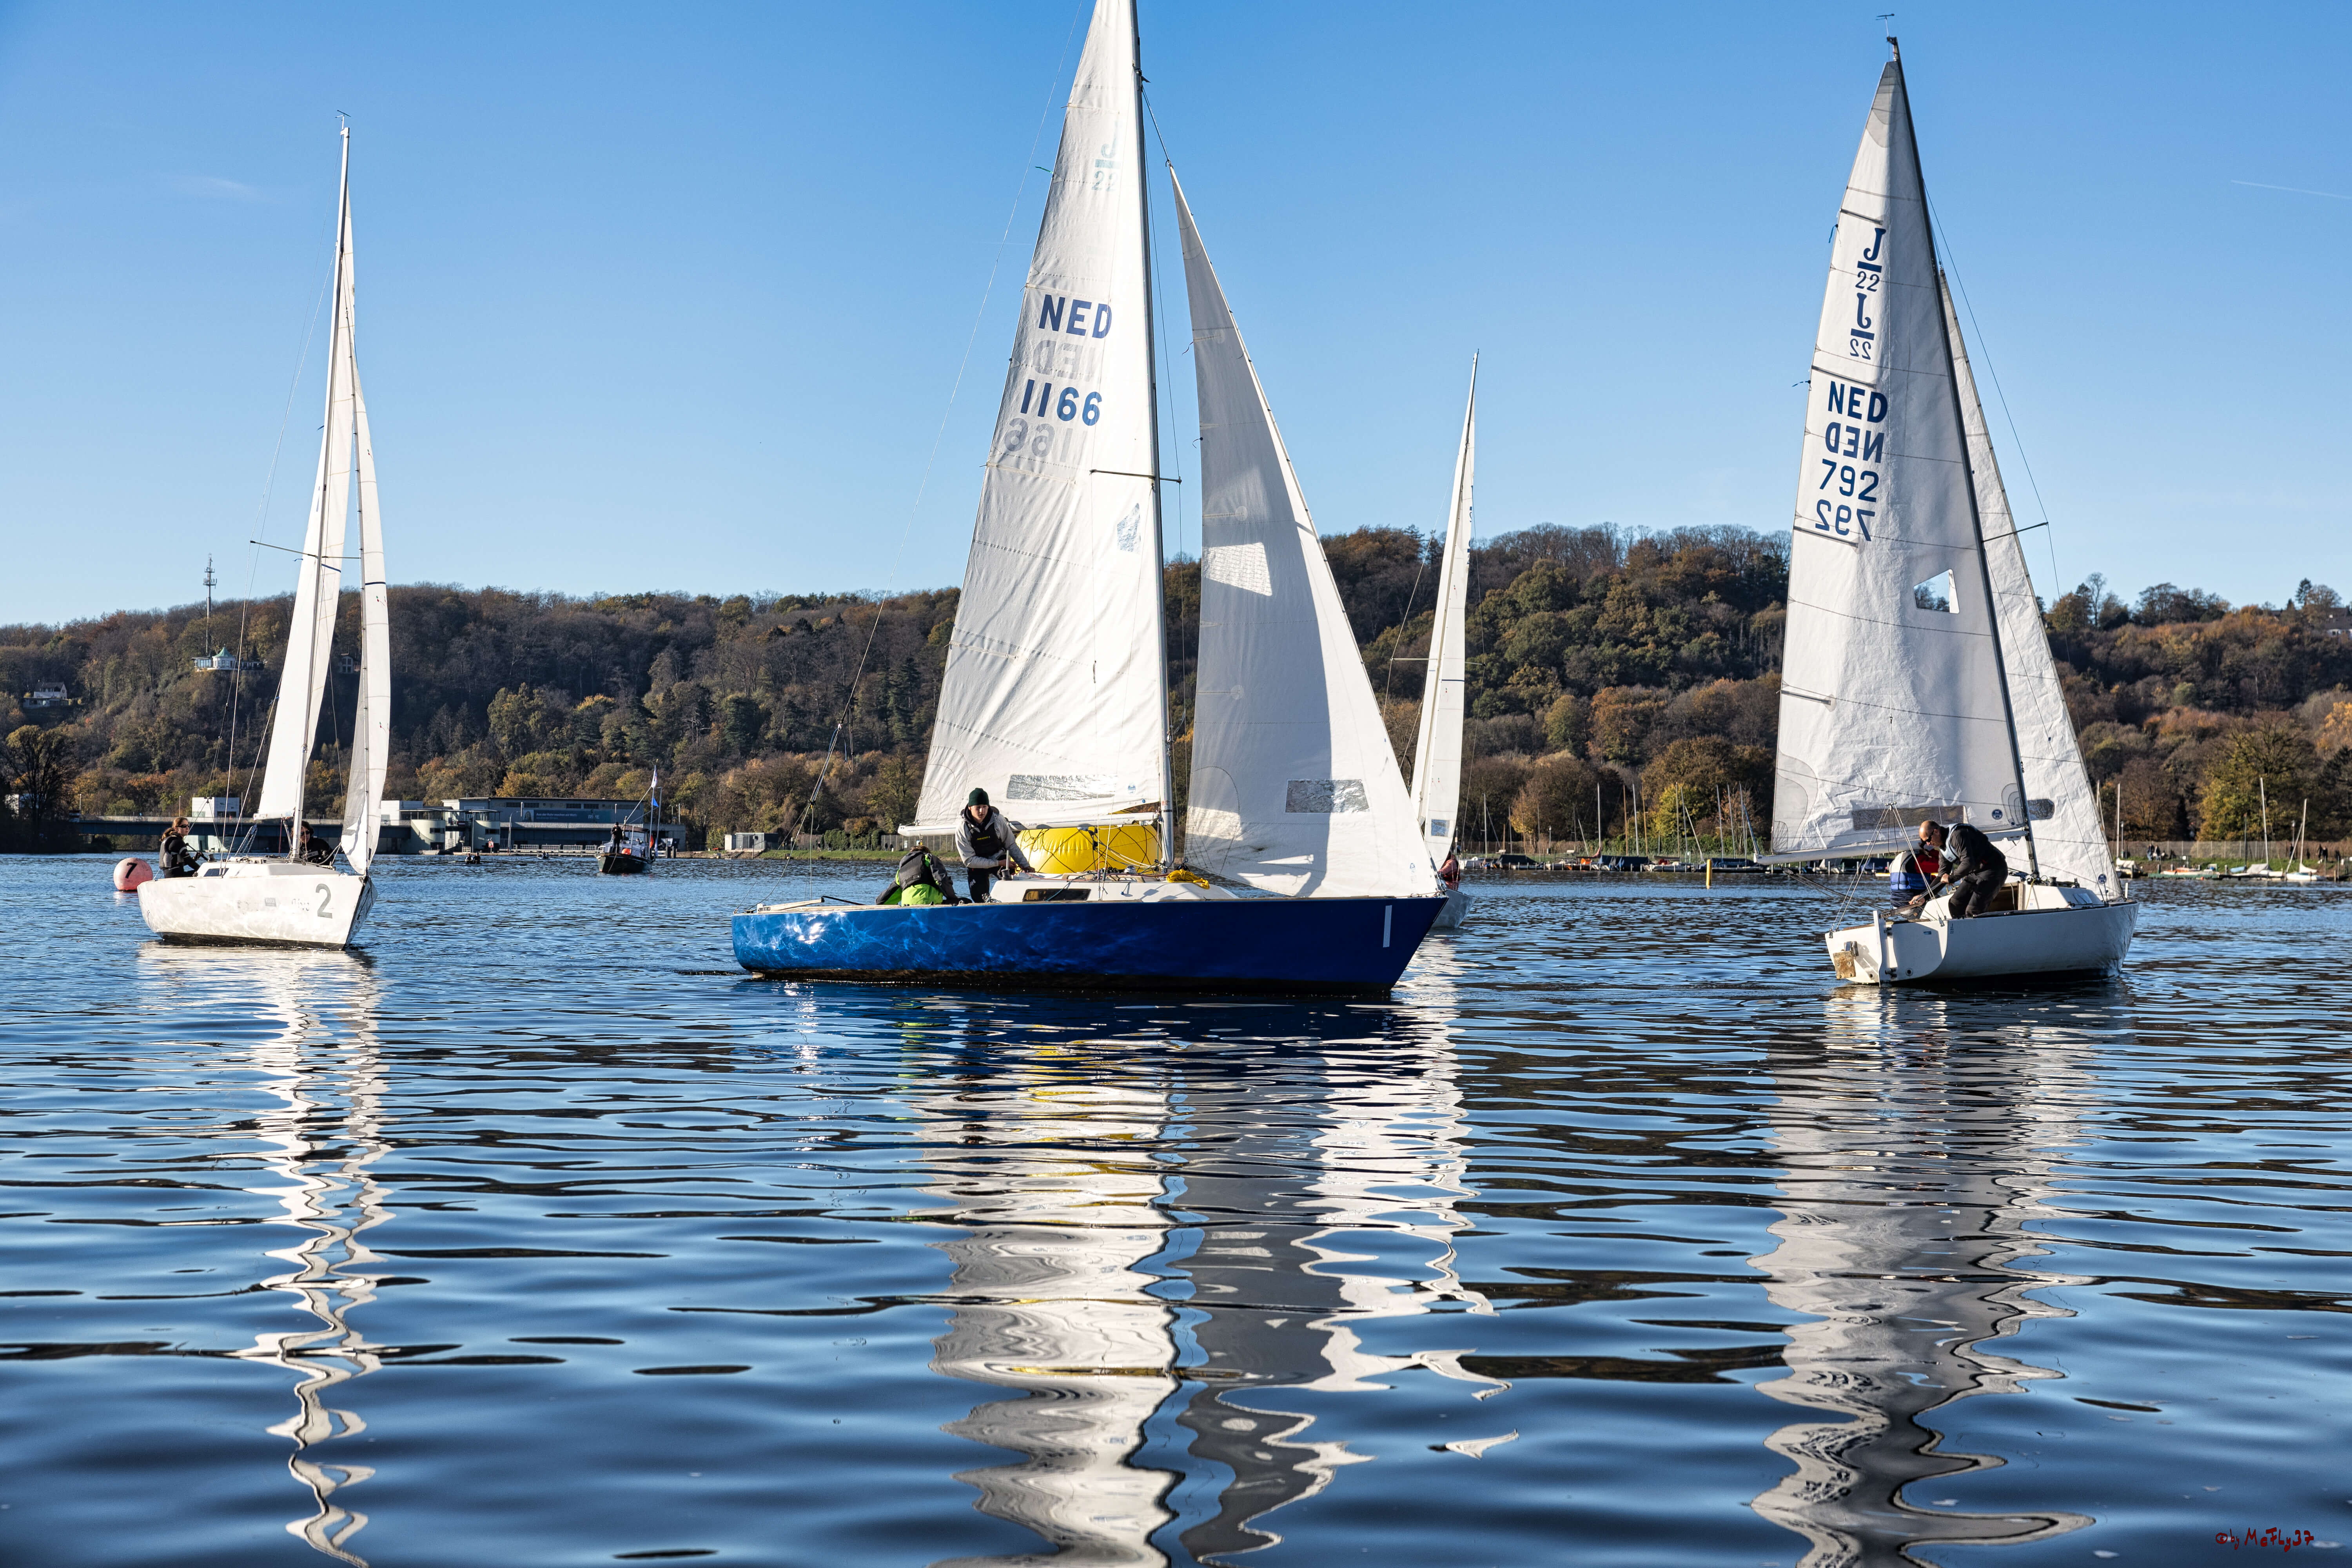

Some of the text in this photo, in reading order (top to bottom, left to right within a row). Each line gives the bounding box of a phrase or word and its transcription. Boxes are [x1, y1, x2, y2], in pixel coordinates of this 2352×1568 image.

[1091, 170, 1120, 192] 22
[1863, 227, 1886, 261] J
[1855, 271, 1880, 292] 22
[1038, 294, 1112, 339] NED
[1020, 379, 1102, 426] 1166
[1828, 381, 1888, 423] NED
[1819, 458, 1879, 503] 792
[125, 862, 138, 879] 7
[316, 883, 332, 919] 2
[1383, 905, 1392, 947] 1
